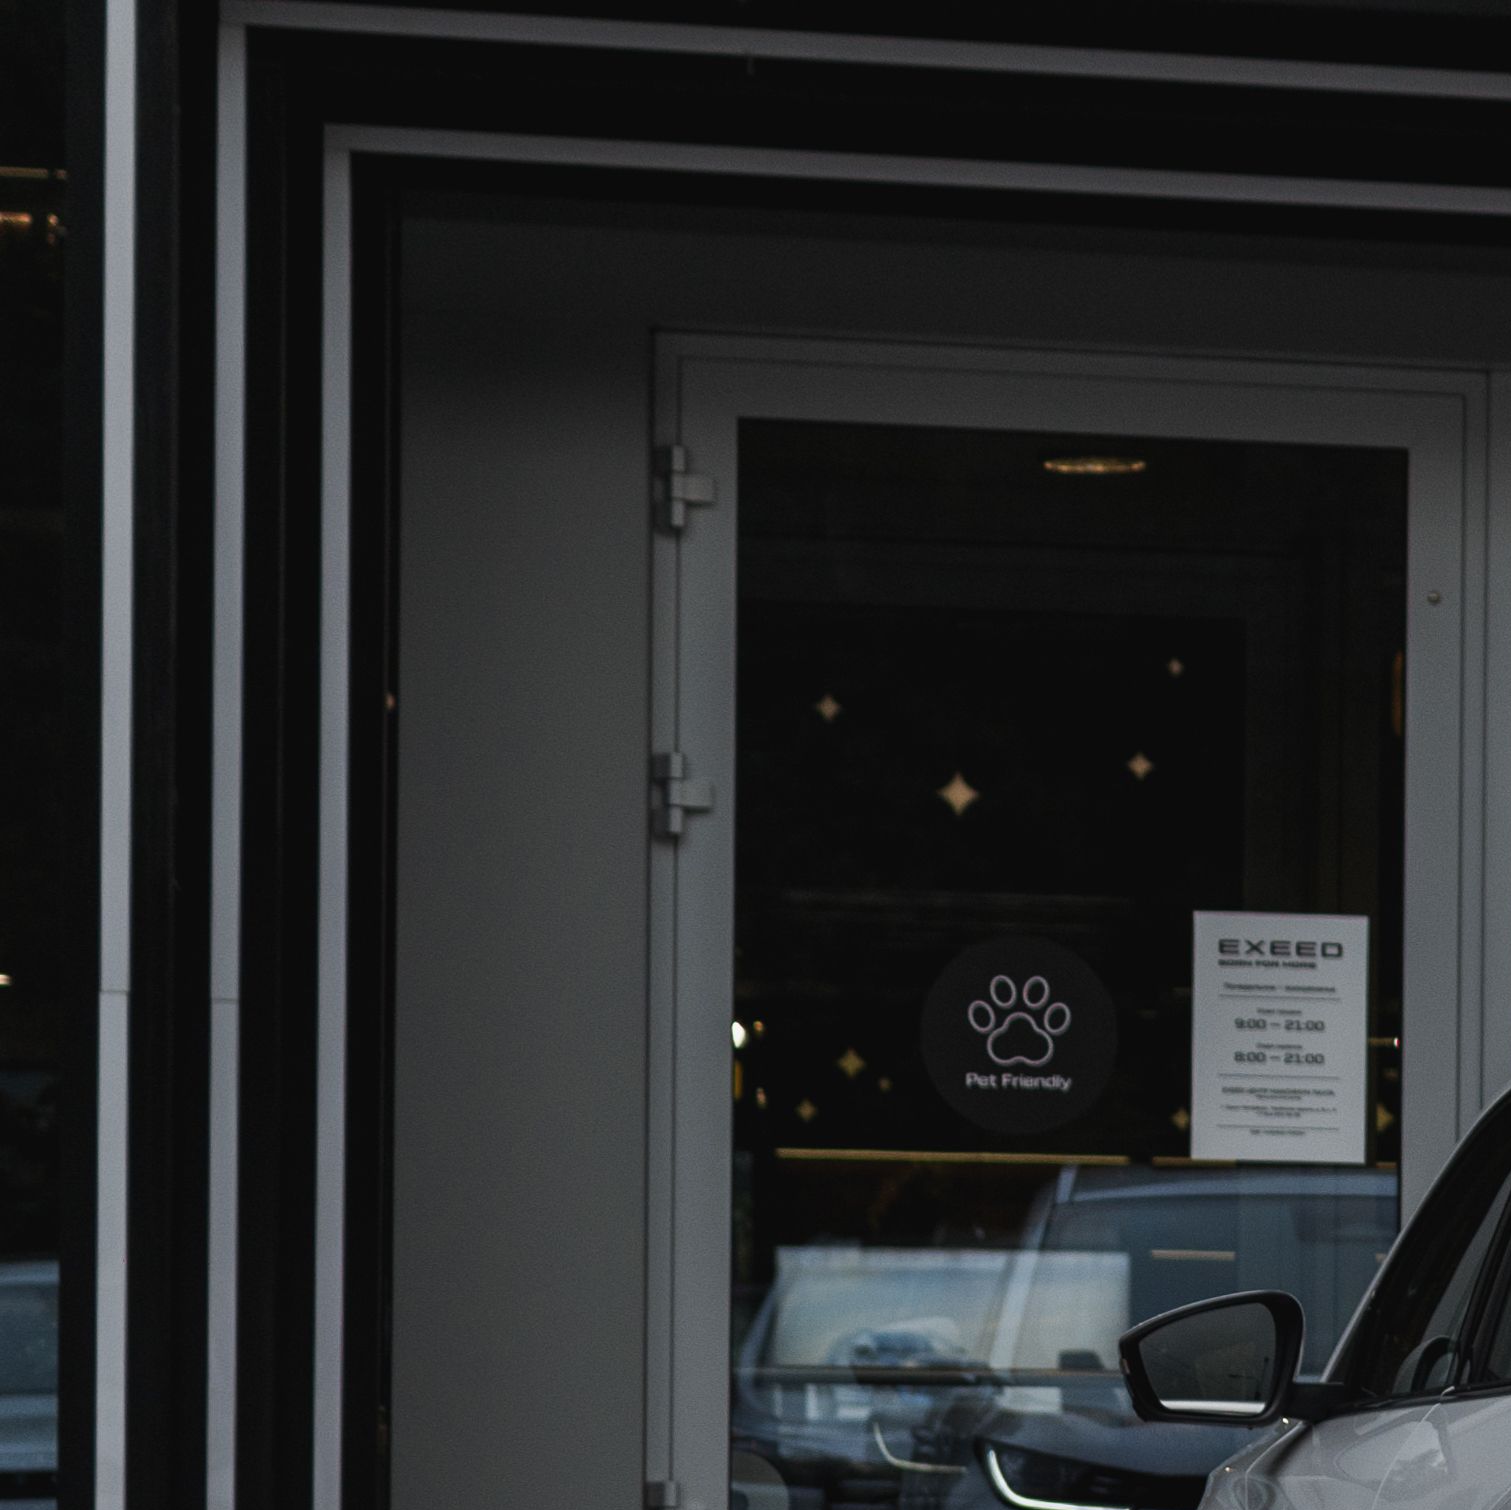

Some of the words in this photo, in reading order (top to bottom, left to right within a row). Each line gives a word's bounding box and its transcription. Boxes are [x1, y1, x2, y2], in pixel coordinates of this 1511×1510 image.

[1218, 939, 1343, 958] EXEED
[1234, 1018, 1266, 1031] 9:00
[1284, 1020, 1325, 1032] 21:00
[1283, 1053, 1325, 1065] 21:00
[964, 1072, 997, 1088] Pet
[1001, 1073, 1072, 1092] Friendly
